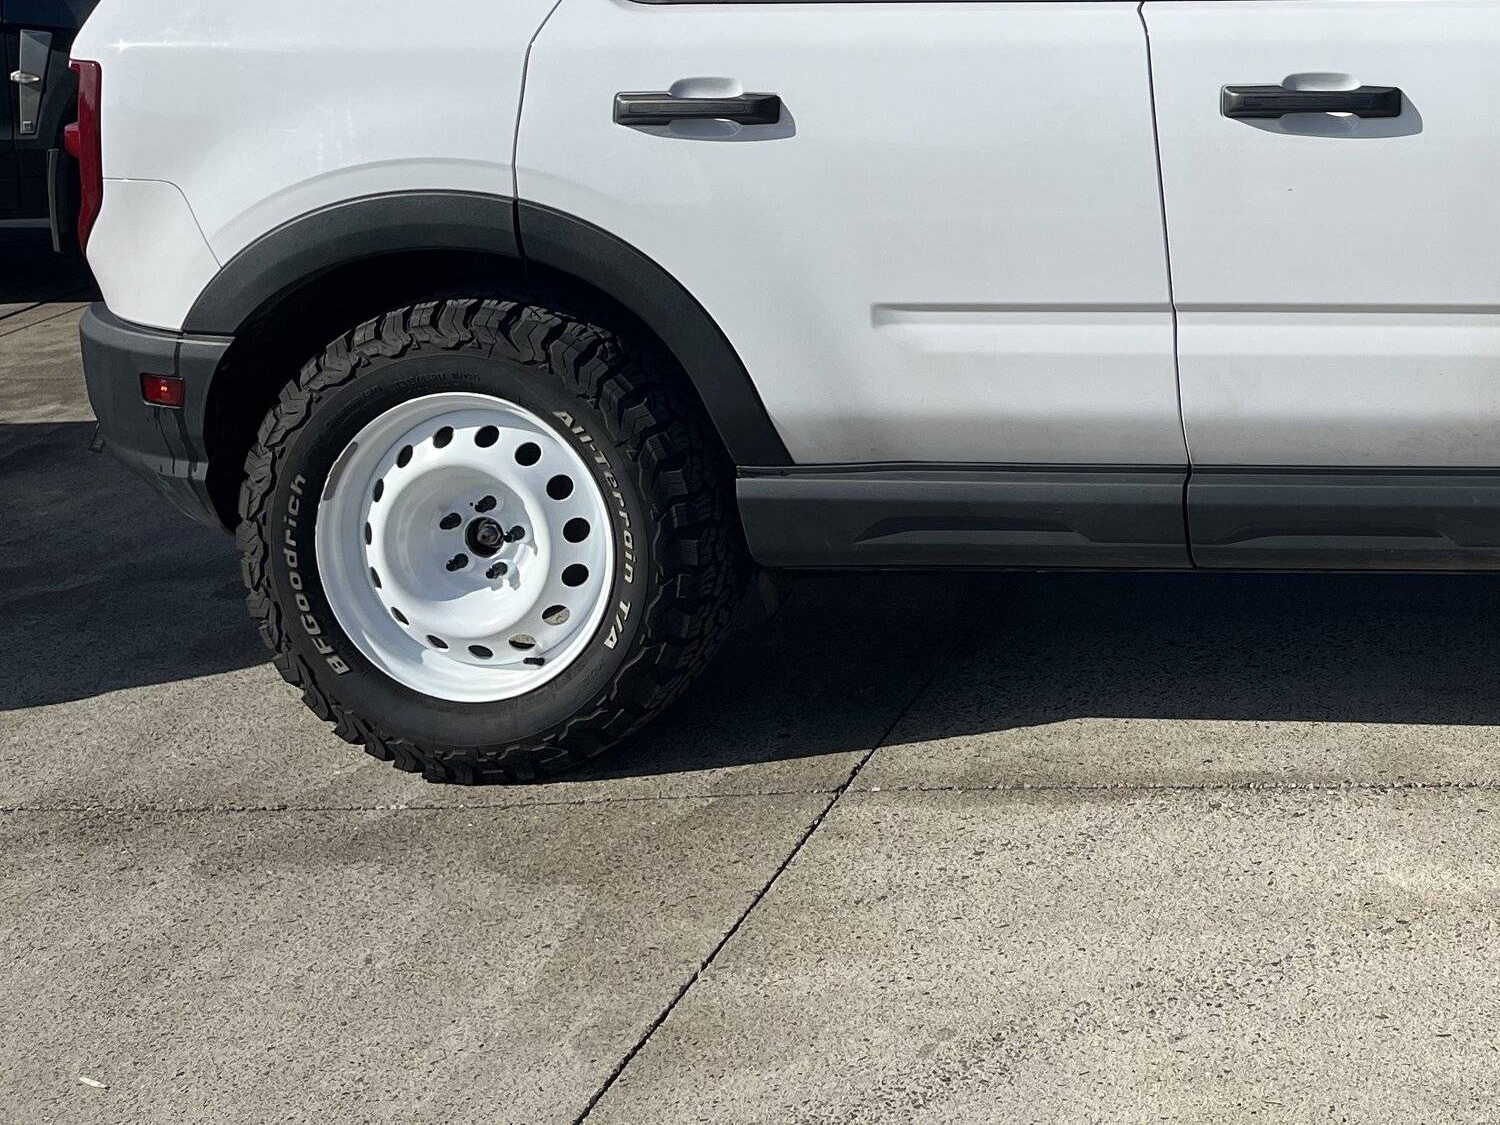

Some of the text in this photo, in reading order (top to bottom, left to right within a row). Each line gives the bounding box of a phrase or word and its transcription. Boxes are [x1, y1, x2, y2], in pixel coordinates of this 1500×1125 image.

[283, 474, 350, 675] BFGoodrich
[552, 411, 637, 650] All-Terrain T/A
